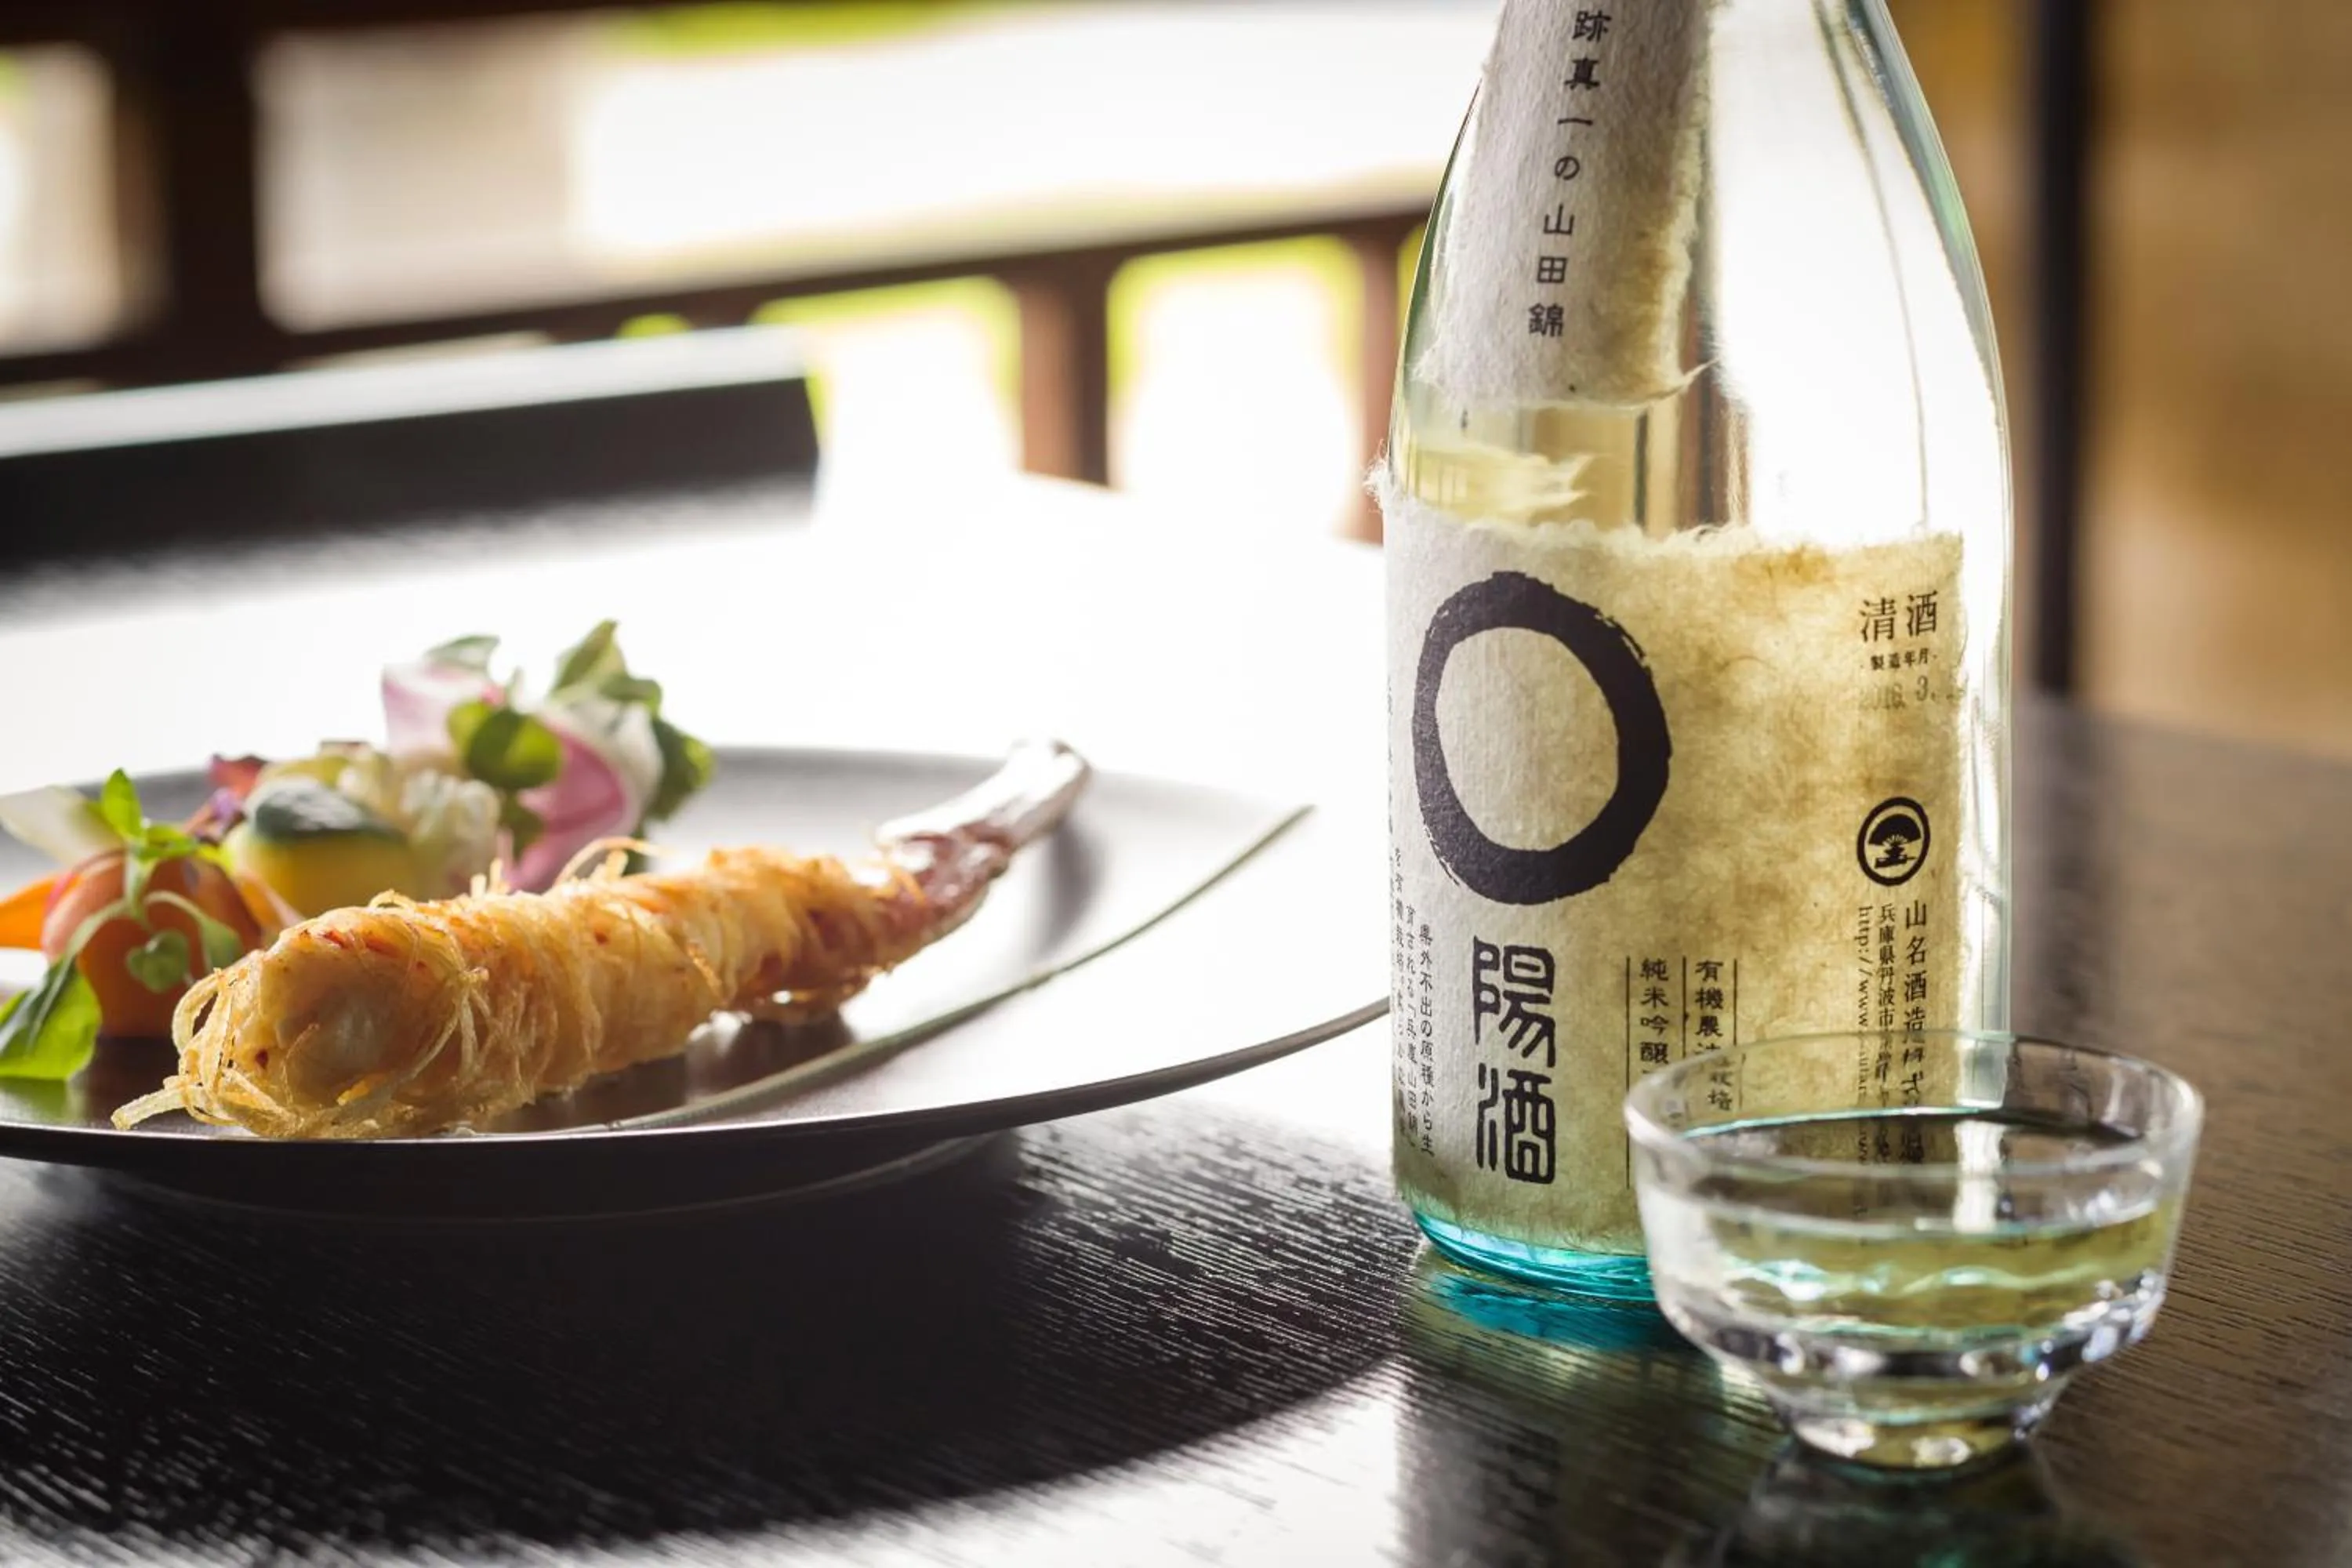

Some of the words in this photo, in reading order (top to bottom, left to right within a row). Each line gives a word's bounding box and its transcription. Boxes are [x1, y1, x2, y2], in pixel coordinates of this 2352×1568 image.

[1528, 9, 1612, 337] 跡真一の山田錦
[1859, 590, 1938, 642] 清酒
[1639, 958, 1670, 1074] 純米吟醸
